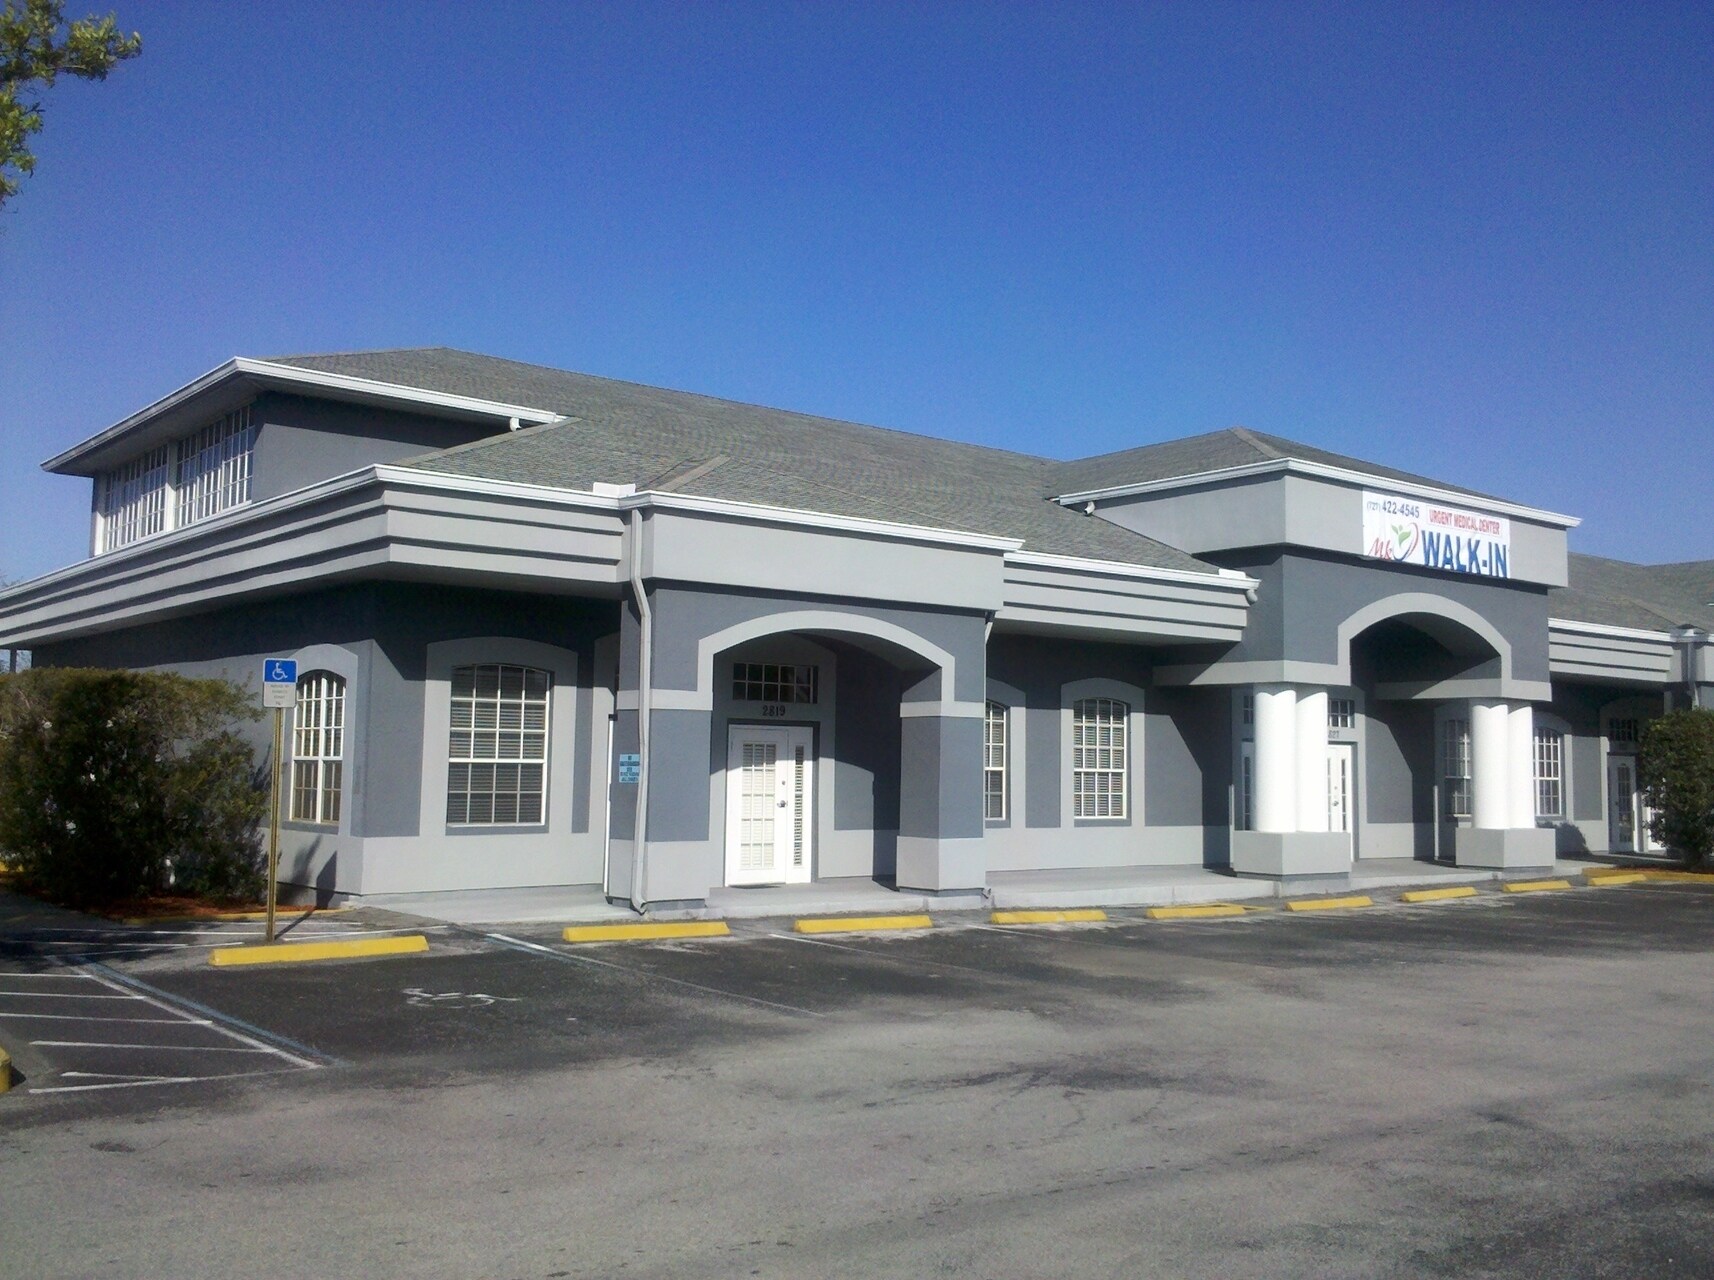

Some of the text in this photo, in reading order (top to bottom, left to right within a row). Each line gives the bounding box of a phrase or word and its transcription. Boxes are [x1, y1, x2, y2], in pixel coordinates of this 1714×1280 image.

[1382, 499, 1420, 519] 422-4545
[1429, 509, 1452, 526] URGENT
[1453, 513, 1478, 531] MEDICAL
[1421, 530, 1508, 579] WALK-IN
[762, 705, 786, 717] 2819
